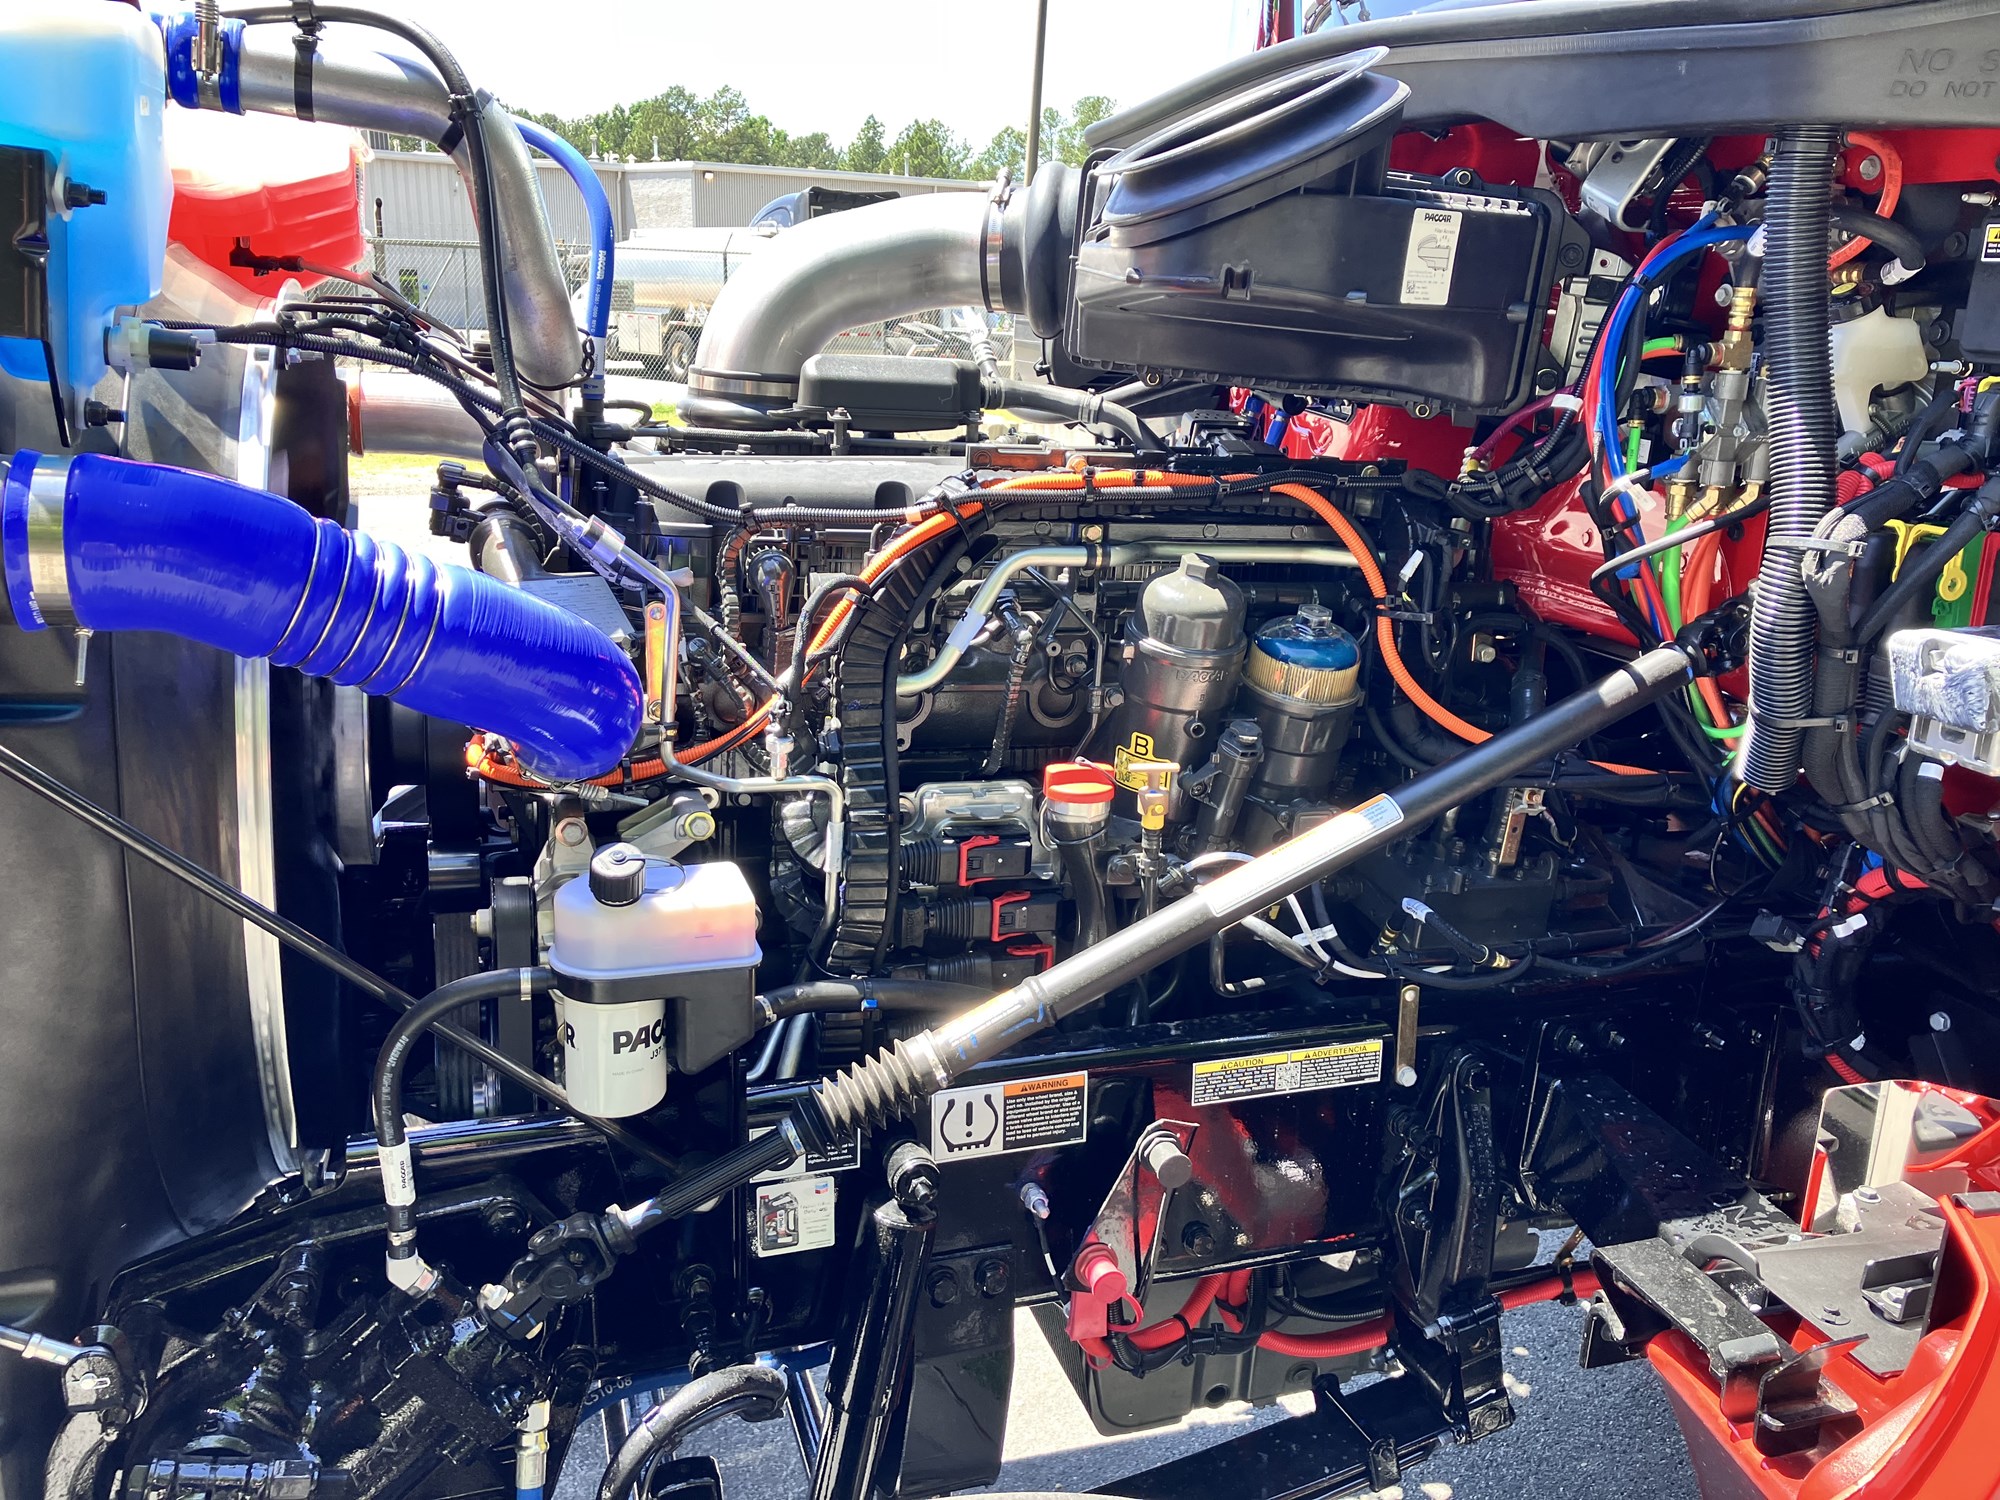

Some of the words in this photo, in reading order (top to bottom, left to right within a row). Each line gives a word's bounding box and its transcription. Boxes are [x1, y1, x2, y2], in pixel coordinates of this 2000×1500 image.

[1898, 48, 1954, 74] NO
[1889, 80, 1927, 98] DO
[1944, 80, 1998, 98] NOT
[1424, 213, 1452, 223] PACCAR
[1134, 735, 1149, 756] B
[1311, 1045, 1368, 1058] ADVERTENCIA
[1227, 1058, 1264, 1069] CAUTION
[1028, 1079, 1069, 1091] WARNING
